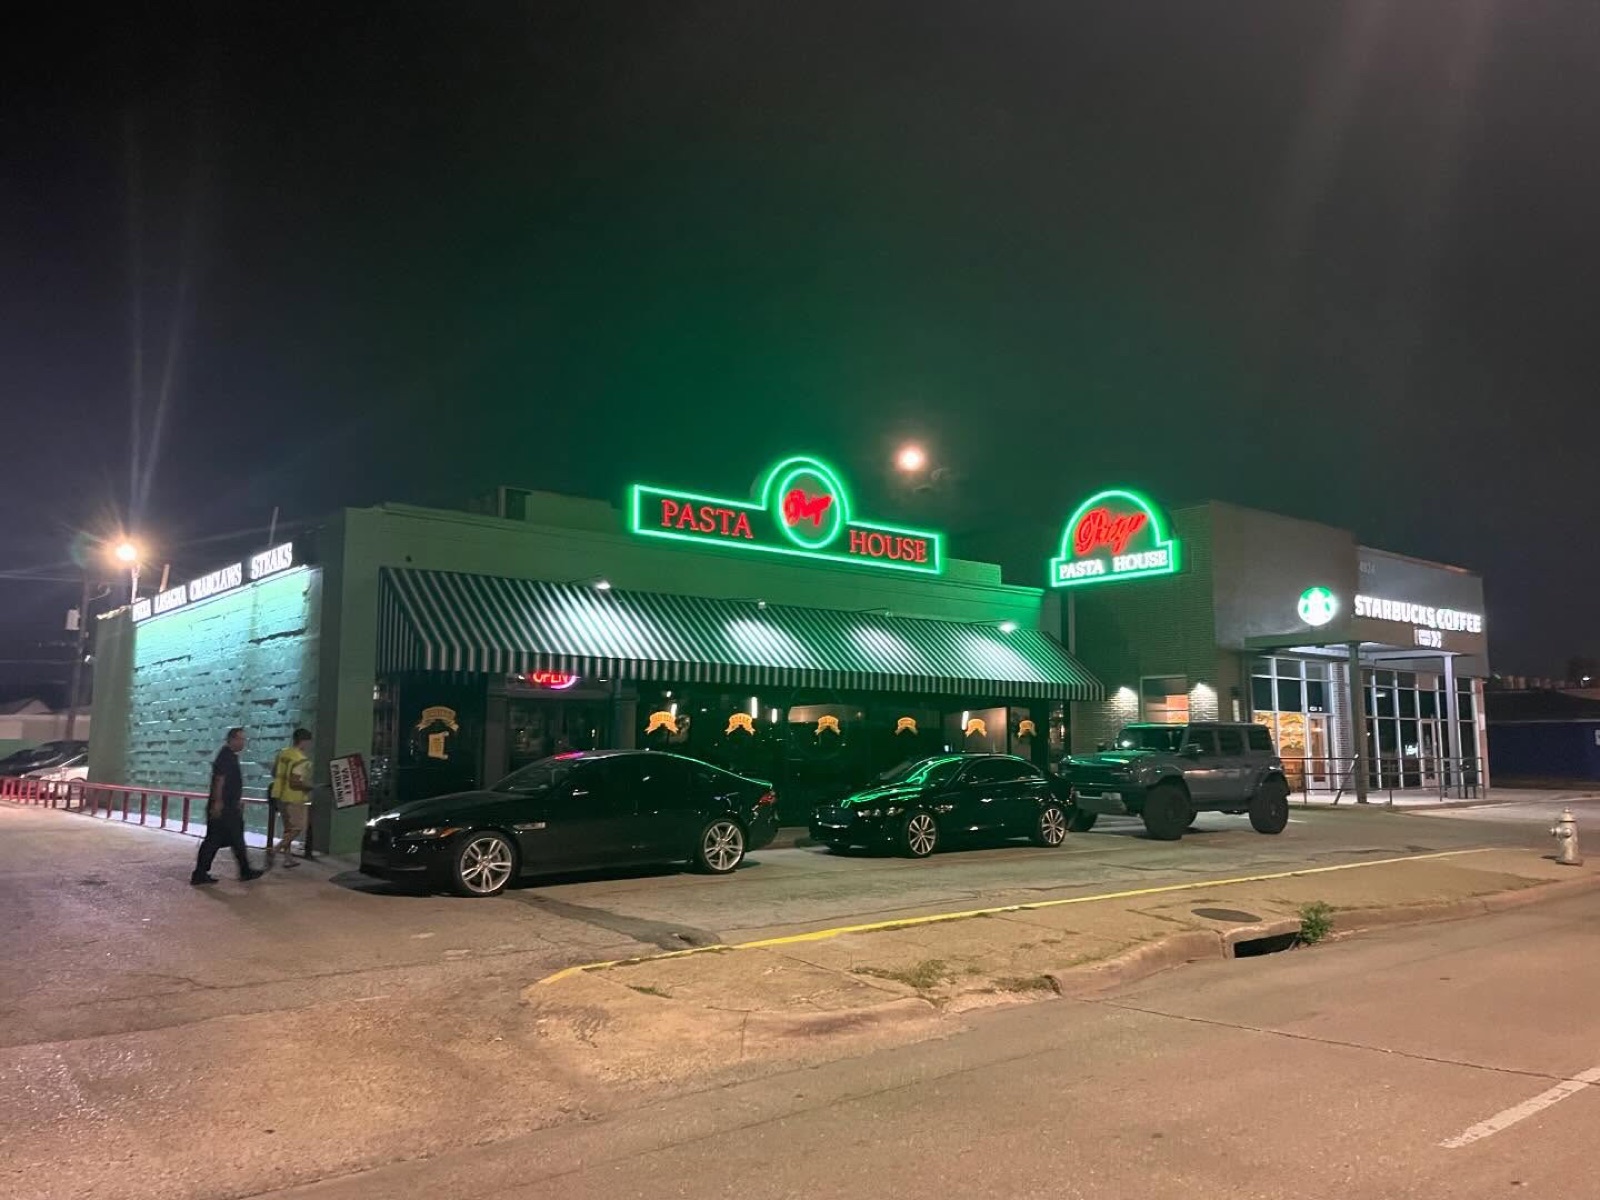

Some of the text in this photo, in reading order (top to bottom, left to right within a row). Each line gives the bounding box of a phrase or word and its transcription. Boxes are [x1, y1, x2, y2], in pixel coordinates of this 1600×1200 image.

[661, 499, 928, 563] PASTA HOUSE
[250, 541, 293, 581] STEAKS
[1059, 549, 1169, 580] PASTA HOUSE
[1354, 594, 1482, 633] STARBUCKS COFFEE
